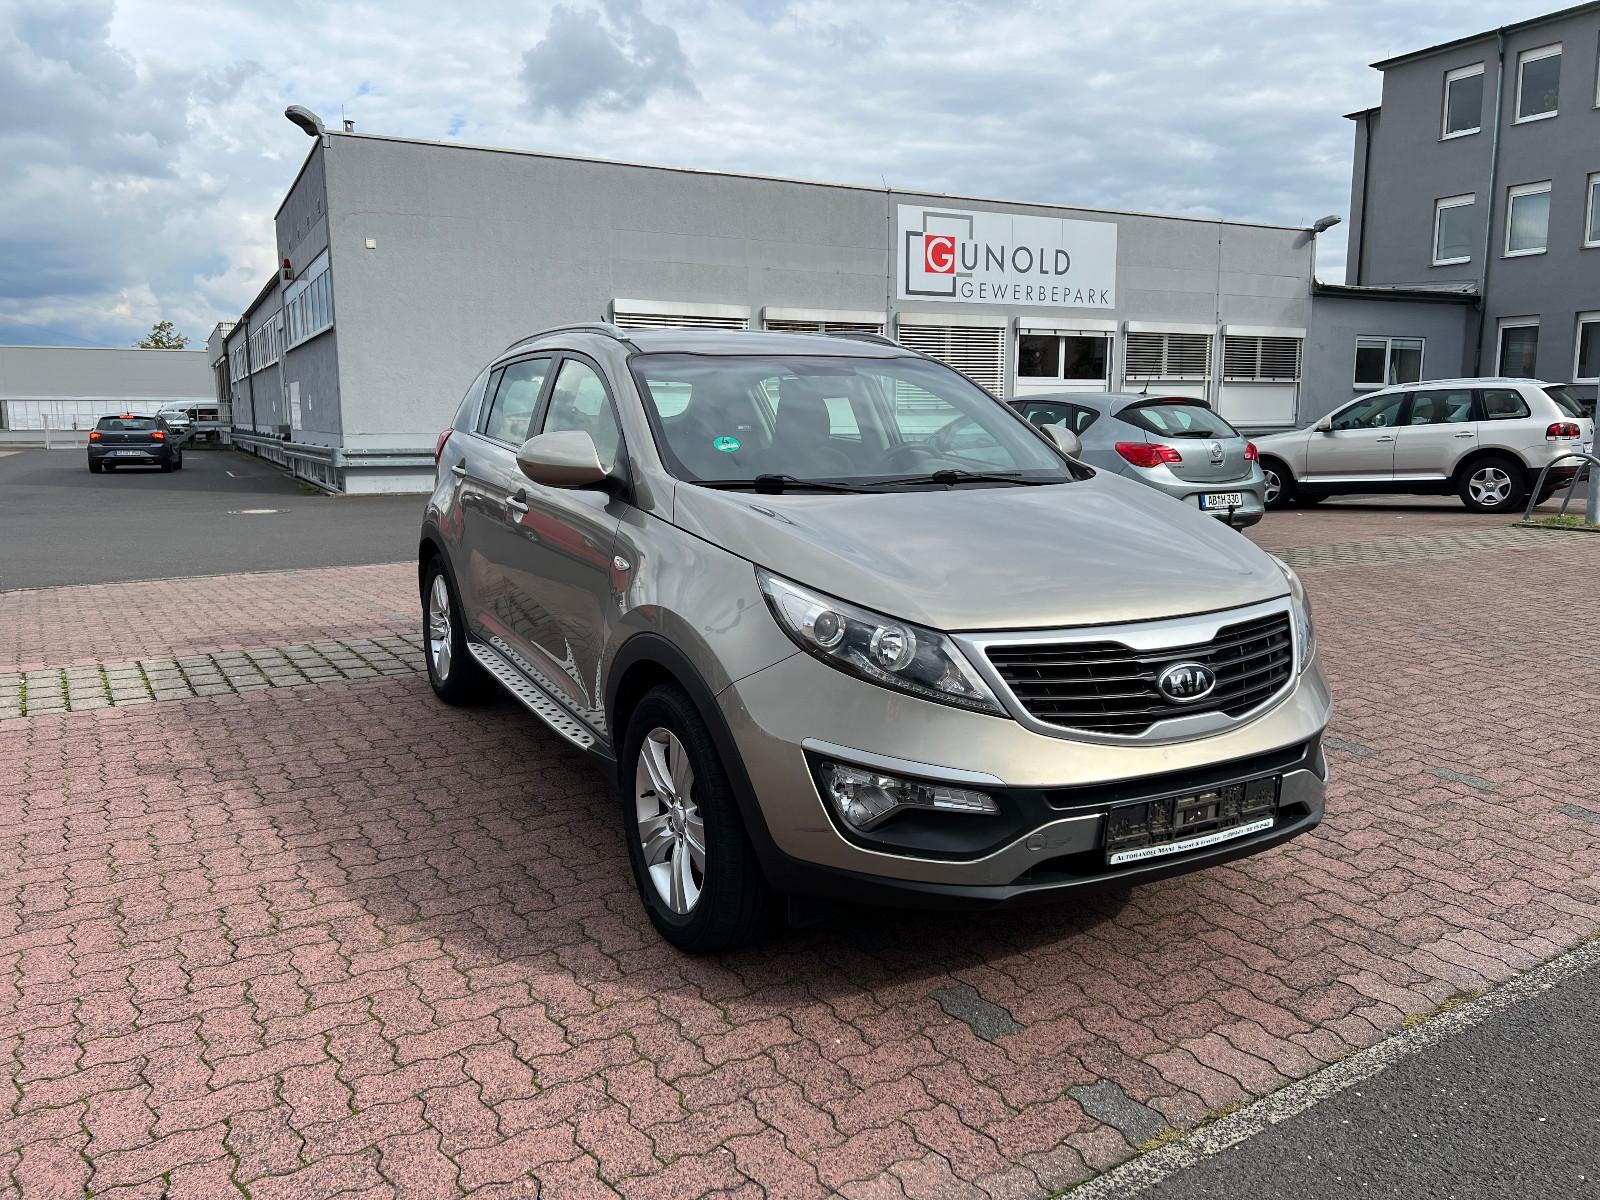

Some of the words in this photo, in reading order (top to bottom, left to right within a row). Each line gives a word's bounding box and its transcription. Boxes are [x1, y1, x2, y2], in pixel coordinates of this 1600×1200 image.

[927, 236, 1071, 275] GUNOLD
[961, 281, 1109, 305] GEWERBEPARK
[1208, 495, 1217, 505] AB
[1169, 671, 1209, 694] KIA
[1117, 849, 1157, 861] AUTOHANDEL
